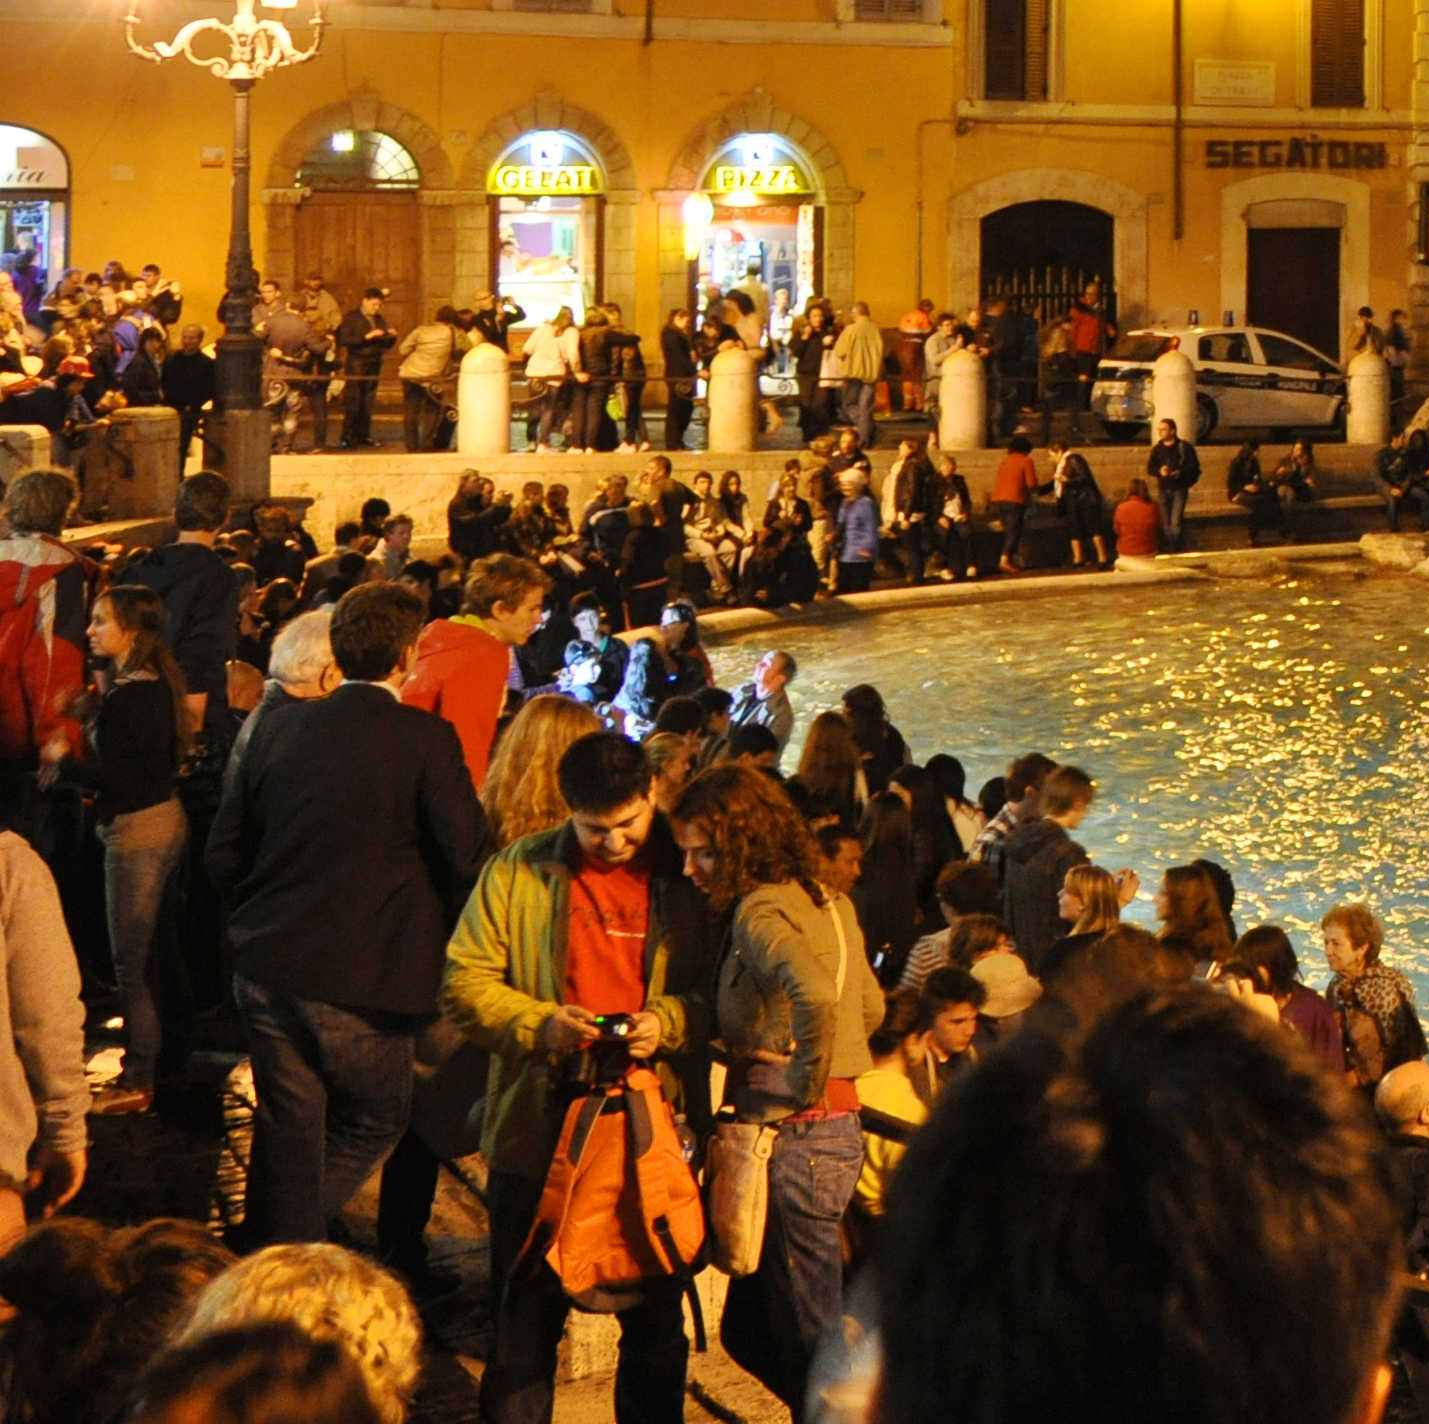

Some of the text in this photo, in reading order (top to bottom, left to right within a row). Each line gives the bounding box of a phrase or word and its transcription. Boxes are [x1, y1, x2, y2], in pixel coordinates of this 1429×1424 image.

[1206, 138, 1387, 169] SEGATORI
[498, 167, 599, 190] GELATI
[717, 166, 801, 189] PIZZA
